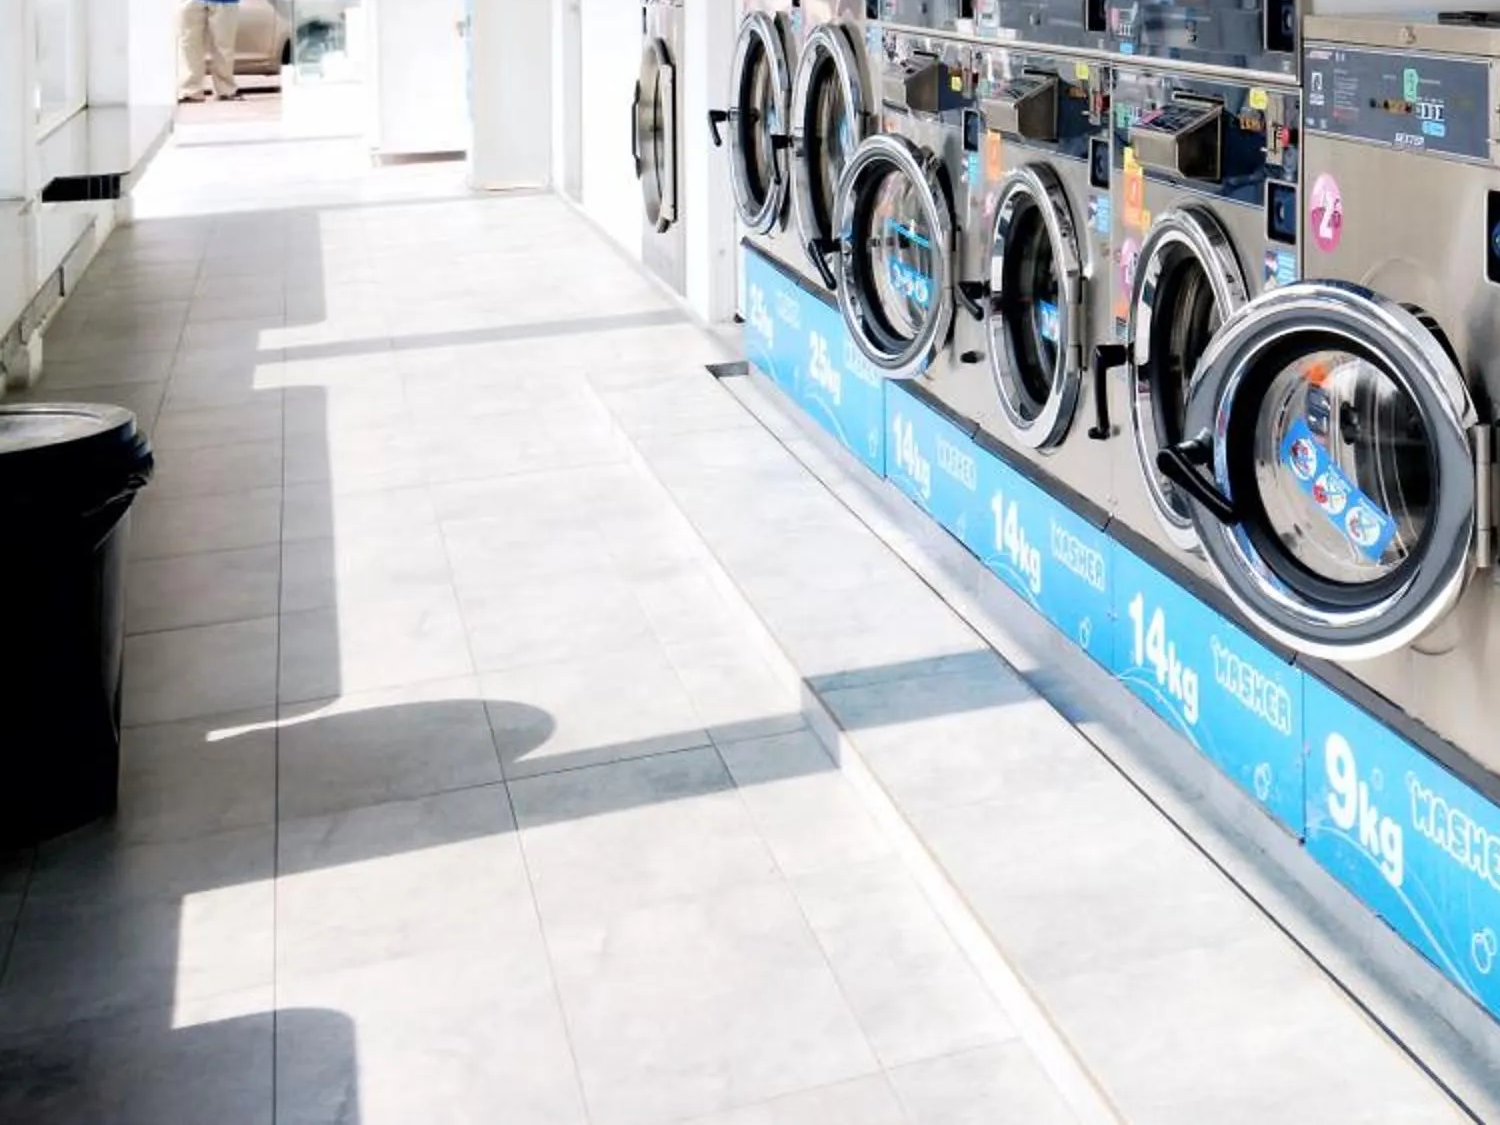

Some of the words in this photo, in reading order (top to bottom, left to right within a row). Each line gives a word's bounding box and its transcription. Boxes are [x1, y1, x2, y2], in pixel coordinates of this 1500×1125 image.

[893, 412, 931, 500] 14kg
[990, 490, 1042, 595] 14kg
[1128, 590, 1199, 726] 14kg
[1323, 730, 1404, 889] 9kg
